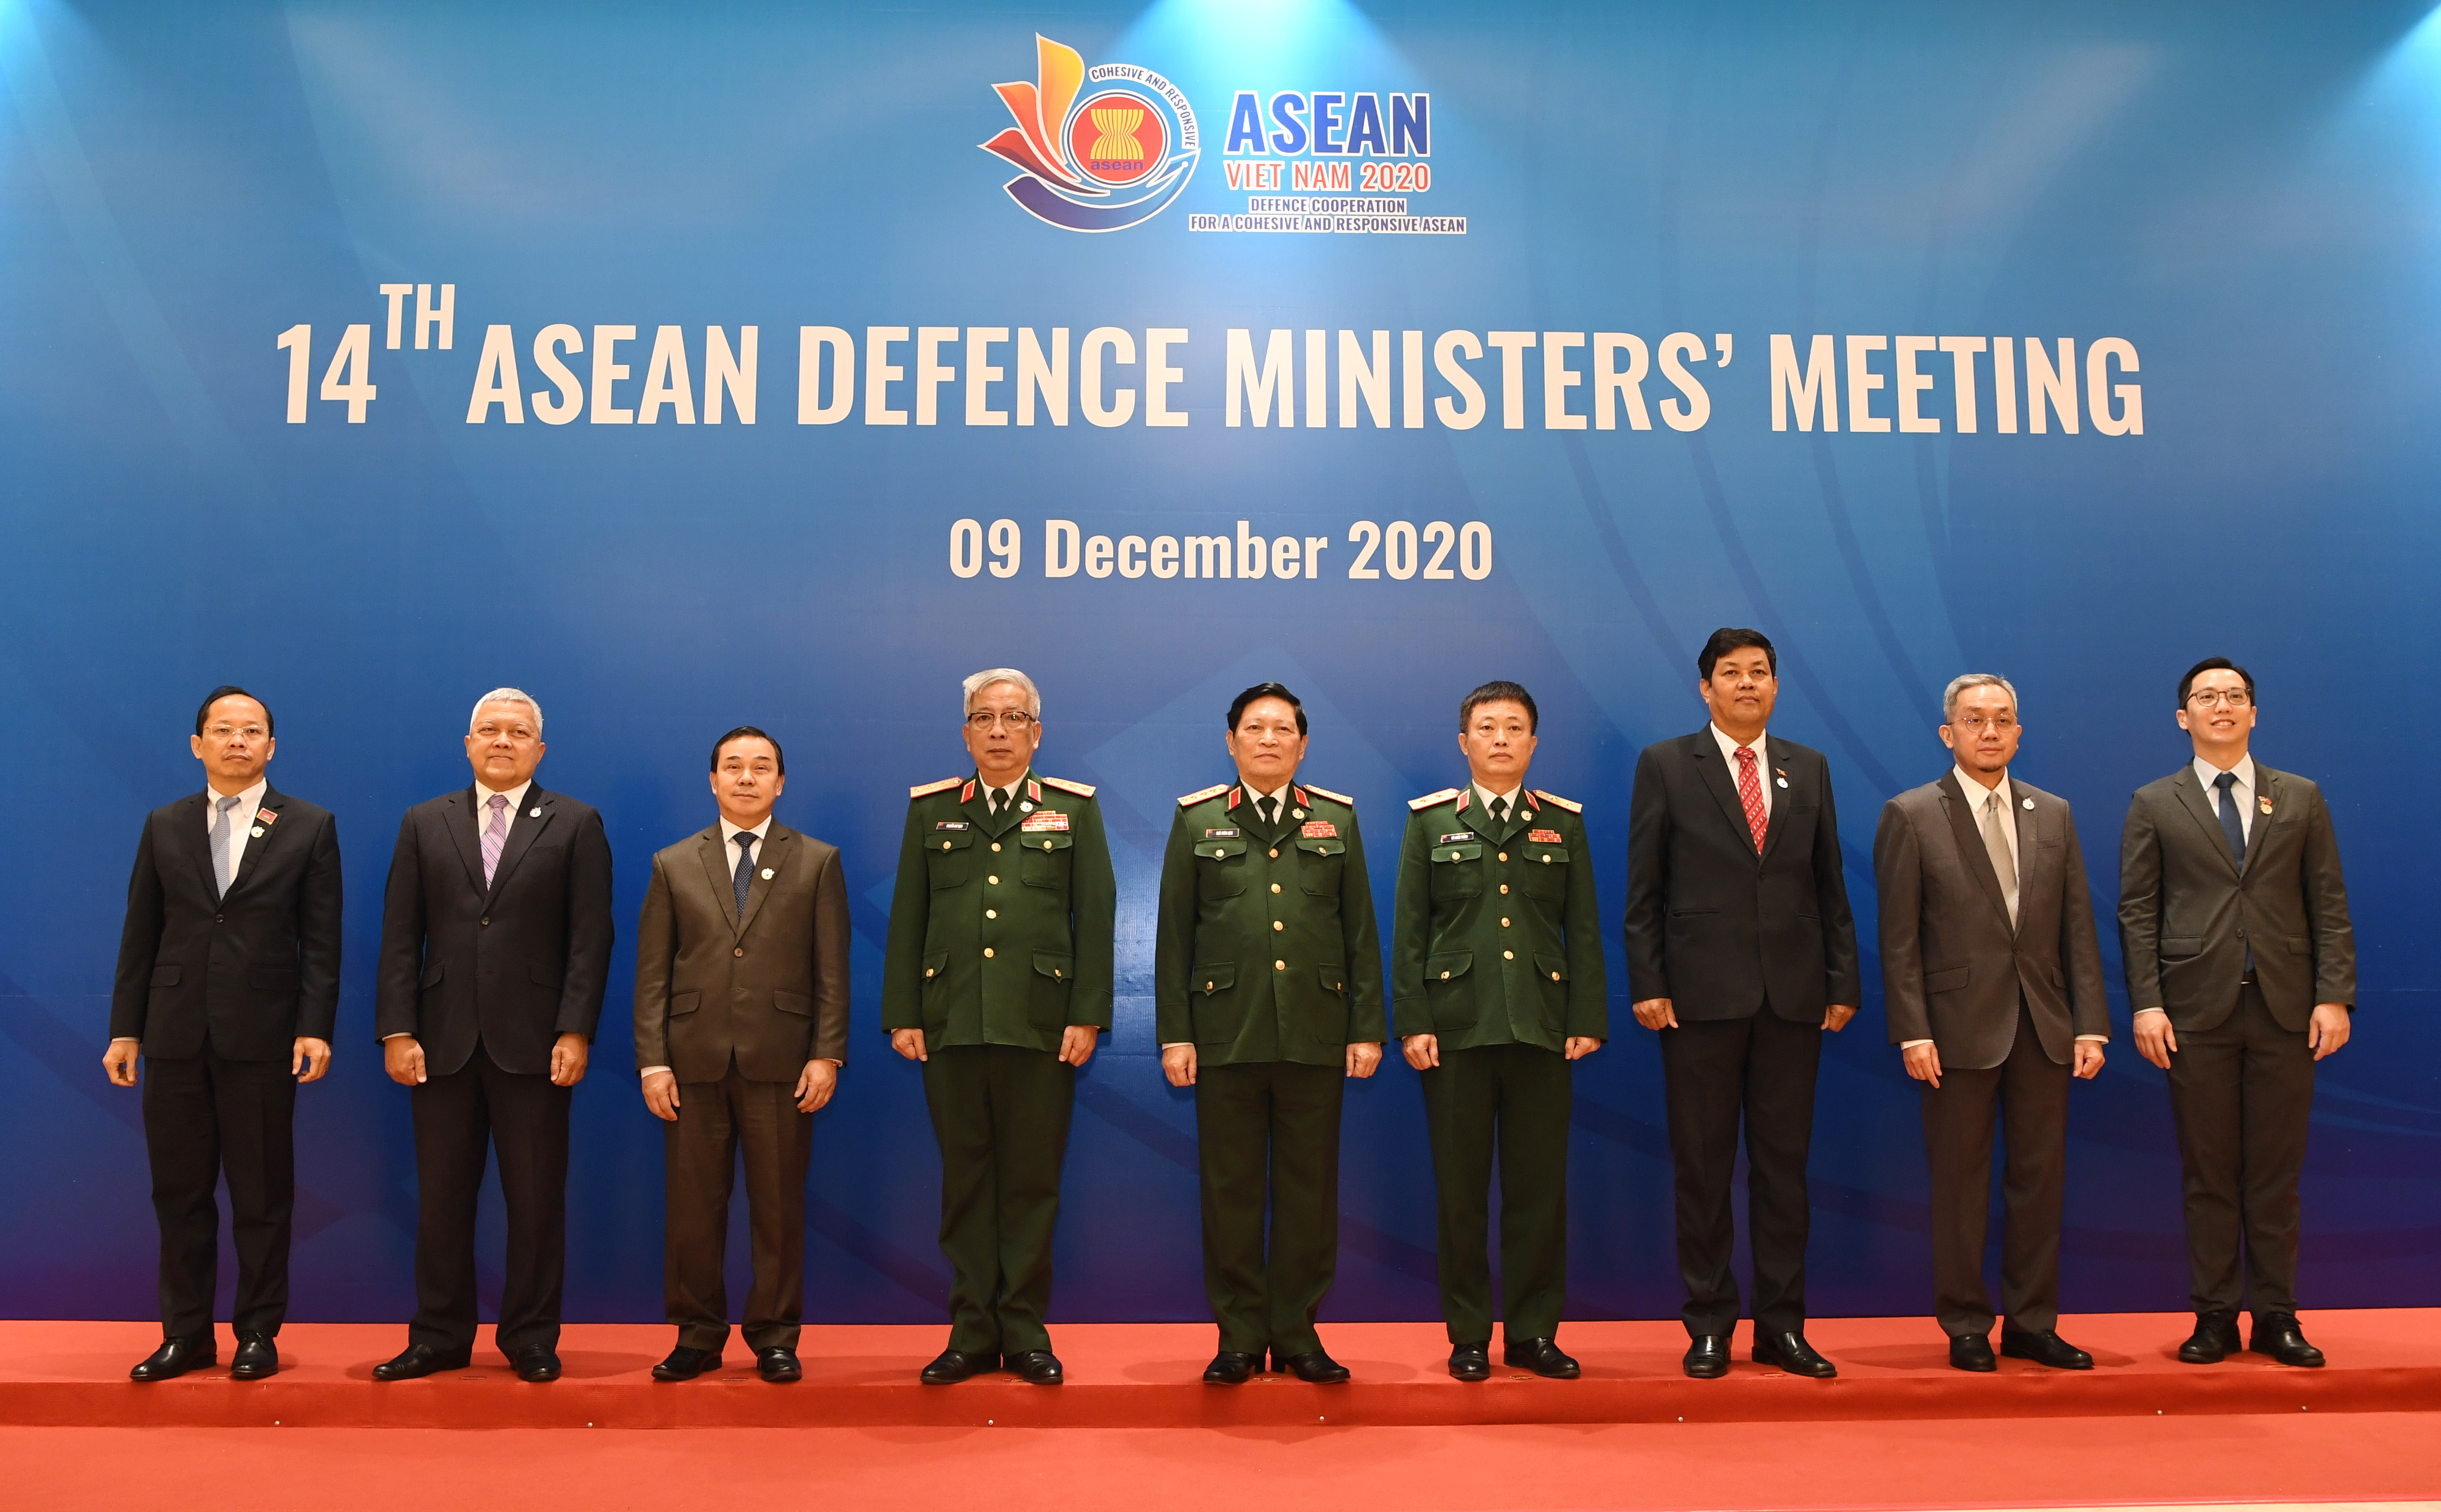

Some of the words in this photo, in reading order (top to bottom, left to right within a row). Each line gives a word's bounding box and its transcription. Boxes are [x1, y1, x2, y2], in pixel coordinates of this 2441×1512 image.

[1091, 66, 1145, 80] COHESIVE
[1145, 74, 1167, 91] AND
[1165, 88, 1196, 146] RESPONSIVE
[1227, 93, 1428, 155] ASEAN
[1091, 161, 1144, 171] asean
[1227, 163, 1282, 188] VIET
[1294, 164, 1349, 189] NAM
[1363, 165, 1428, 190] 2020
[1191, 216, 1217, 229] FOR
[1221, 216, 1230, 229] A
[1235, 217, 1300, 230] COHESIVE
[1304, 217, 1331, 231] AND
[1336, 218, 1420, 232] RESPONSIVE
[1423, 218, 1464, 232] ASEAN
[1251, 199, 1307, 212] DEFENCE
[1312, 199, 1405, 213] COOPERATION
[466, 324, 759, 425] ASEAN
[797, 326, 1189, 427] DEFENCE
[1225, 328, 1733, 432] MINISTERS’
[1770, 334, 2144, 436] MEETING
[950, 518, 1021, 578] 09
[1045, 520, 1328, 579] December
[1348, 520, 1492, 580] 2020
